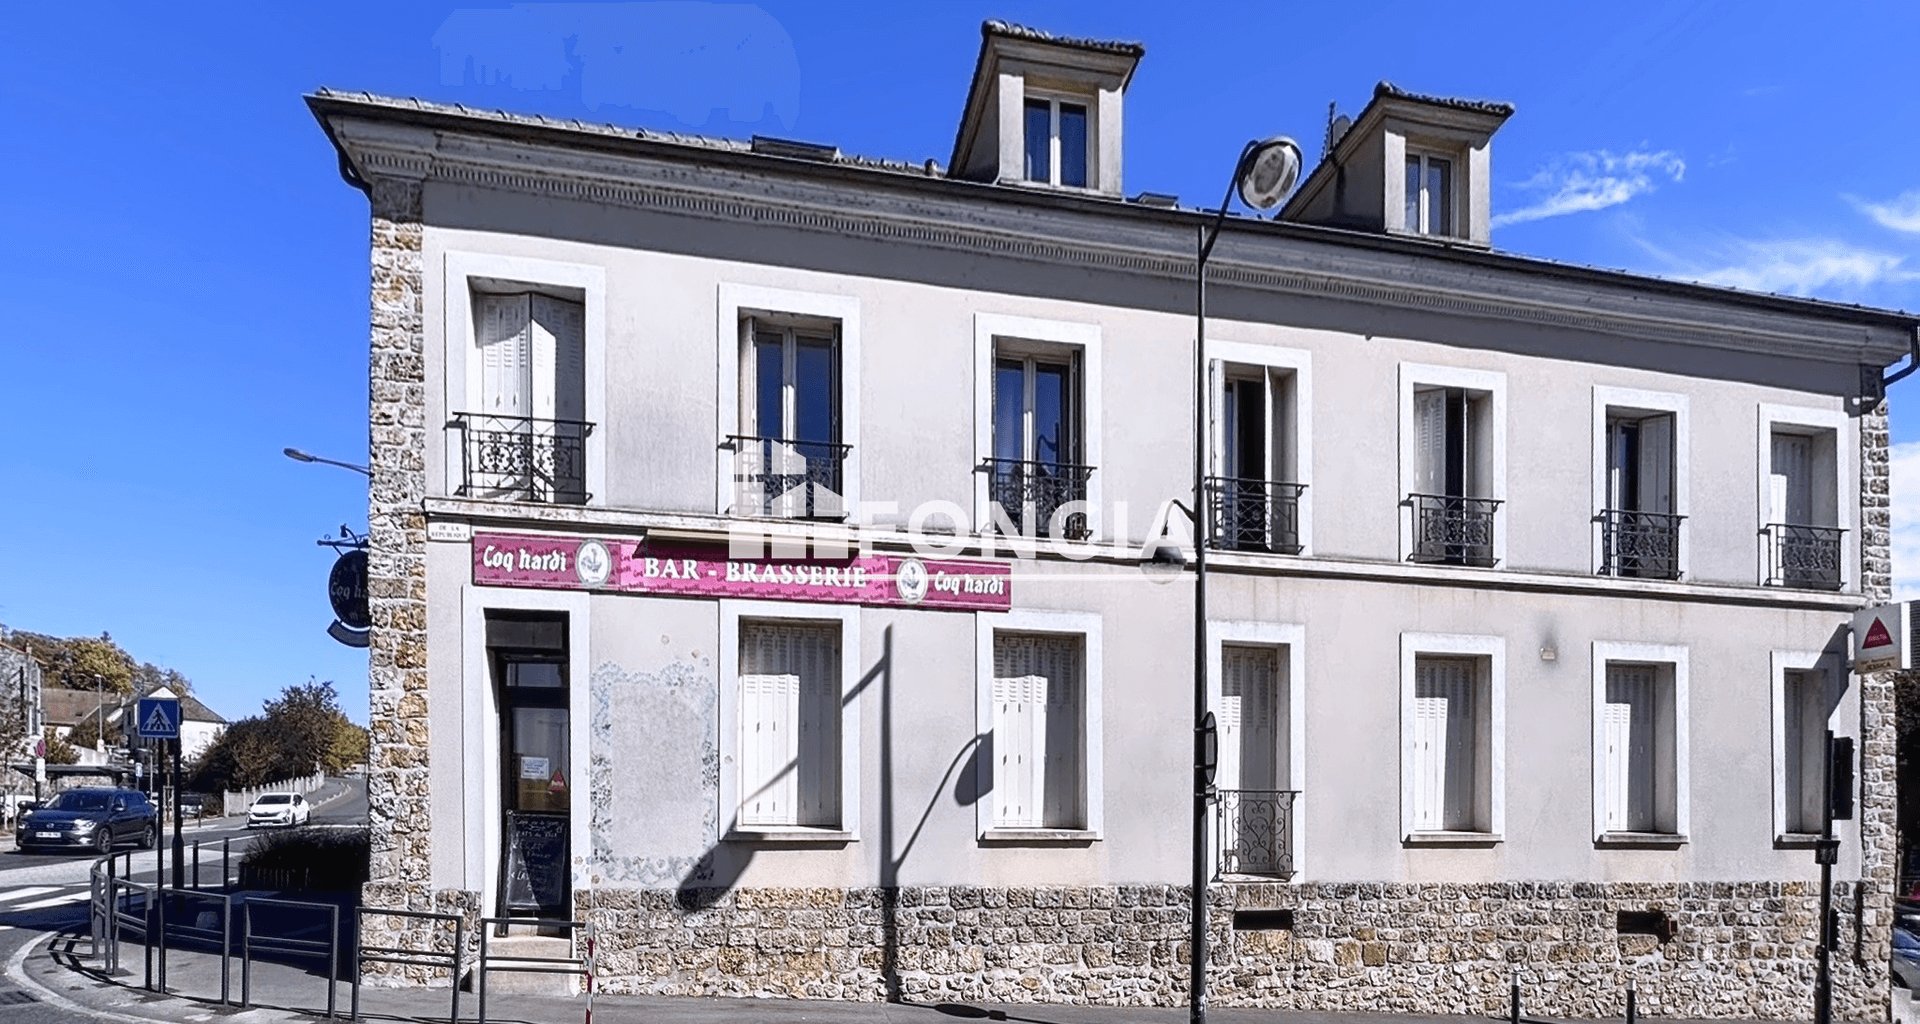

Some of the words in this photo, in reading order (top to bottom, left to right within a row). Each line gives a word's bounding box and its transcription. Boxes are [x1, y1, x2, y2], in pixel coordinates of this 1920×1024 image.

[483, 545, 514, 572] Coq
[519, 549, 567, 572] hardi
[645, 557, 700, 580] BAR
[726, 561, 867, 588] BRASSERIE
[934, 570, 960, 596] Coq
[963, 573, 1005, 595] hardi
[330, 581, 350, 600] Coq
